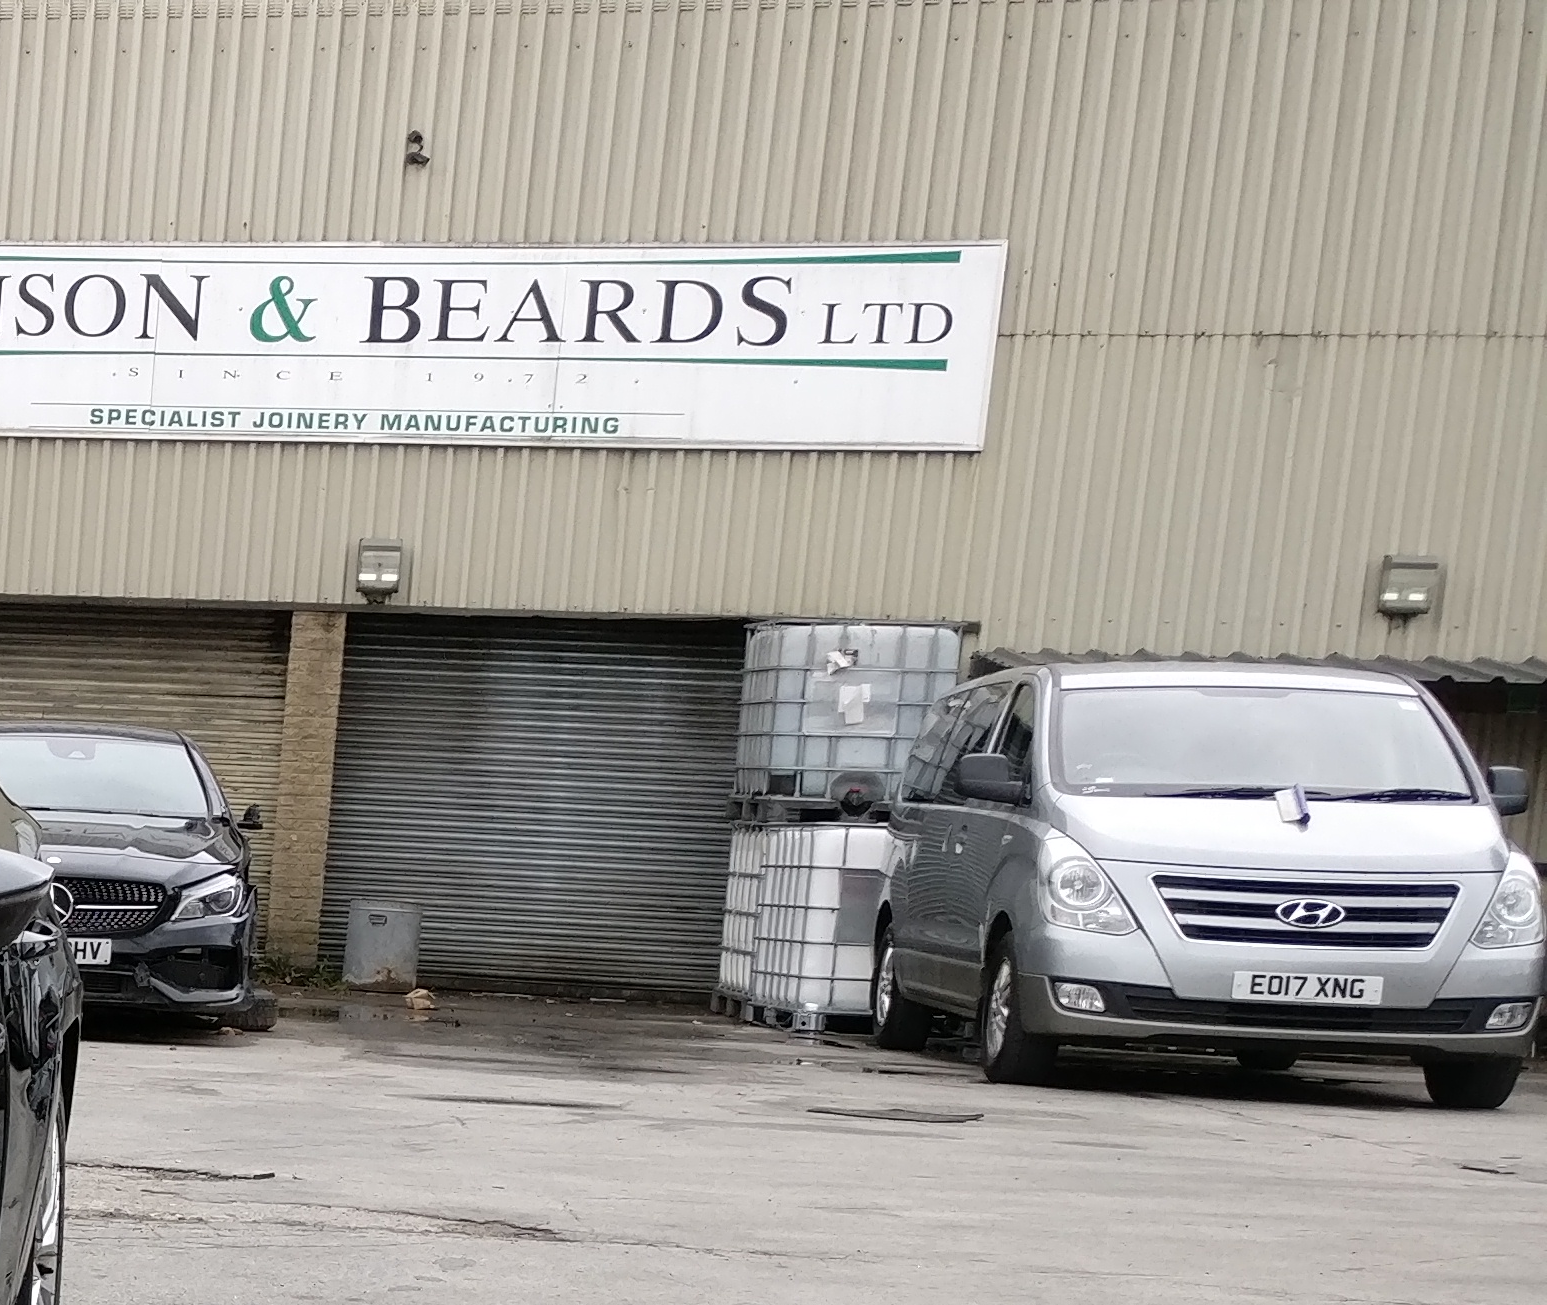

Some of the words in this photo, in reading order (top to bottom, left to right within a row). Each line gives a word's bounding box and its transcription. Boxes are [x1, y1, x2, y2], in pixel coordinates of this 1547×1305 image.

[249, 275, 318, 343] &
[360, 276, 795, 347] BEARDS
[819, 302, 953, 345] LTD
[89, 407, 242, 429] SPECIALIST
[252, 411, 368, 432] JOINERY
[380, 413, 620, 436] MANUFACTURING
[68, 941, 102, 960] HV
[1314, 976, 1366, 999] XNG
